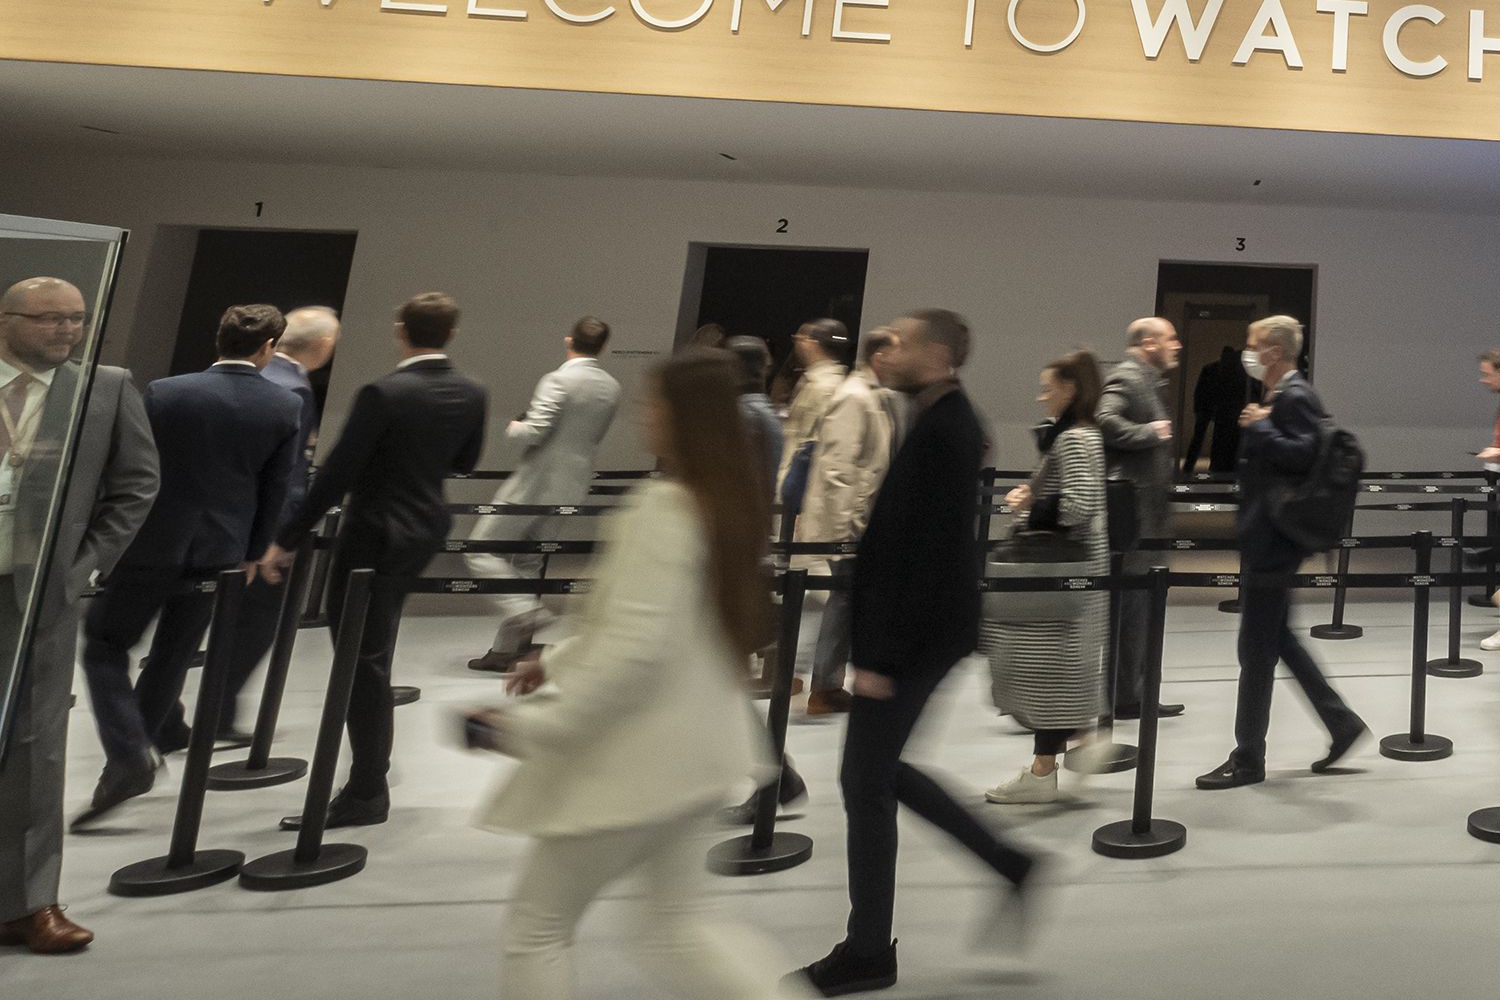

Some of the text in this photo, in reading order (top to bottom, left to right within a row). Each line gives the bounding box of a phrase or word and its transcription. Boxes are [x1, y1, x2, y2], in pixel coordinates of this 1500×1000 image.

[255, 202, 263, 217] 1
[776, 218, 788, 233] 2
[1236, 237, 1246, 251] 3
